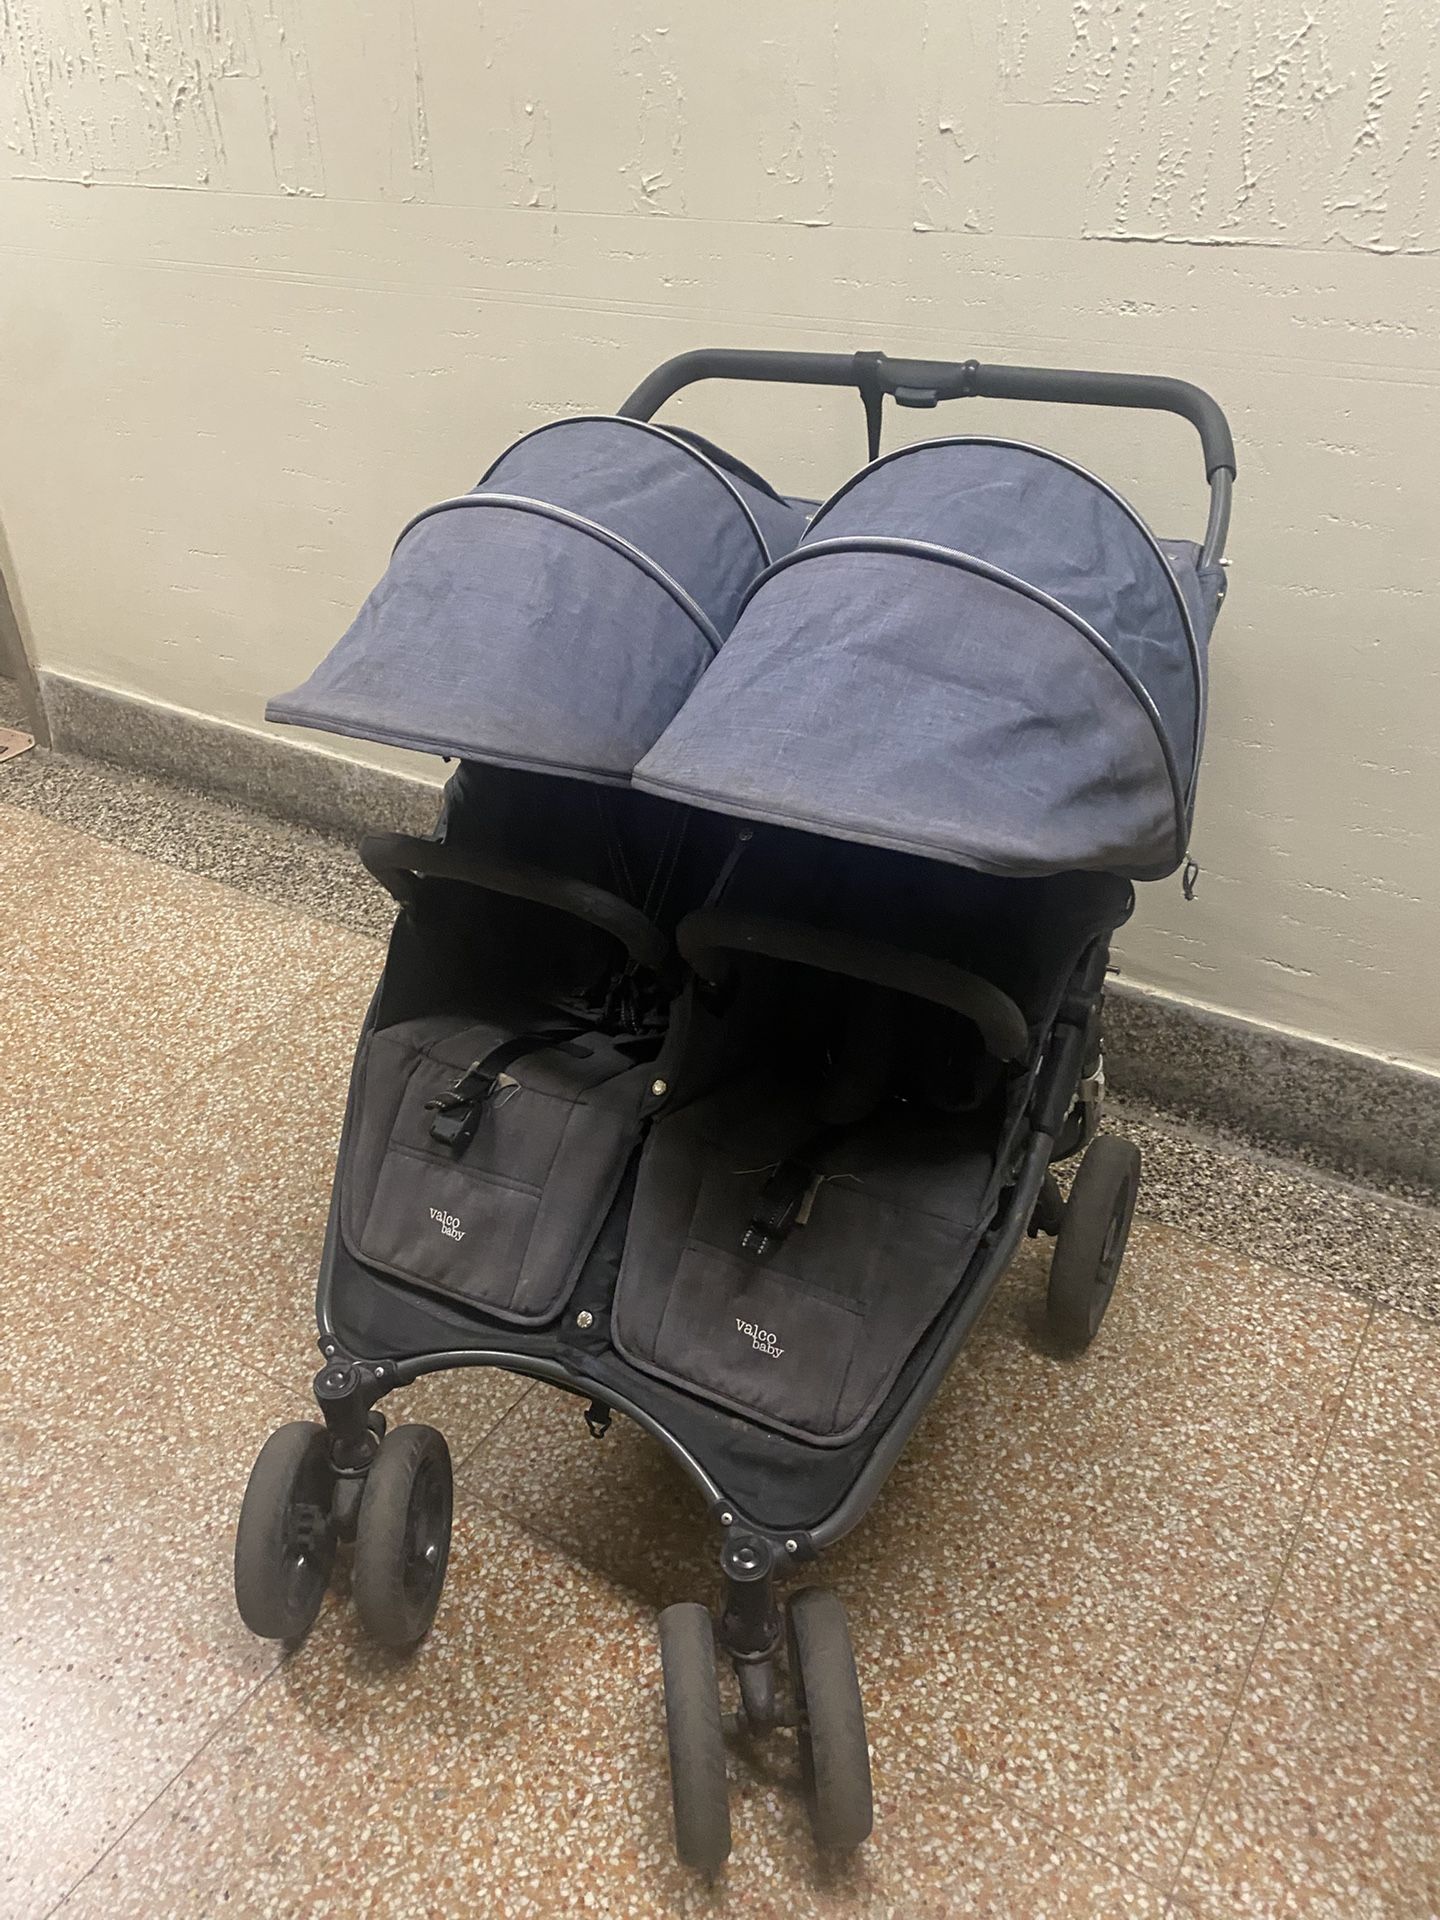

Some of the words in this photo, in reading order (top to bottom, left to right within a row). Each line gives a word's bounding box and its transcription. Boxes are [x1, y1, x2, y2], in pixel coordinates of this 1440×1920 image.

[429, 1207, 461, 1229] valco
[441, 1221, 466, 1241] baby
[735, 1318, 777, 1345] valco
[752, 1337, 784, 1358] baby
